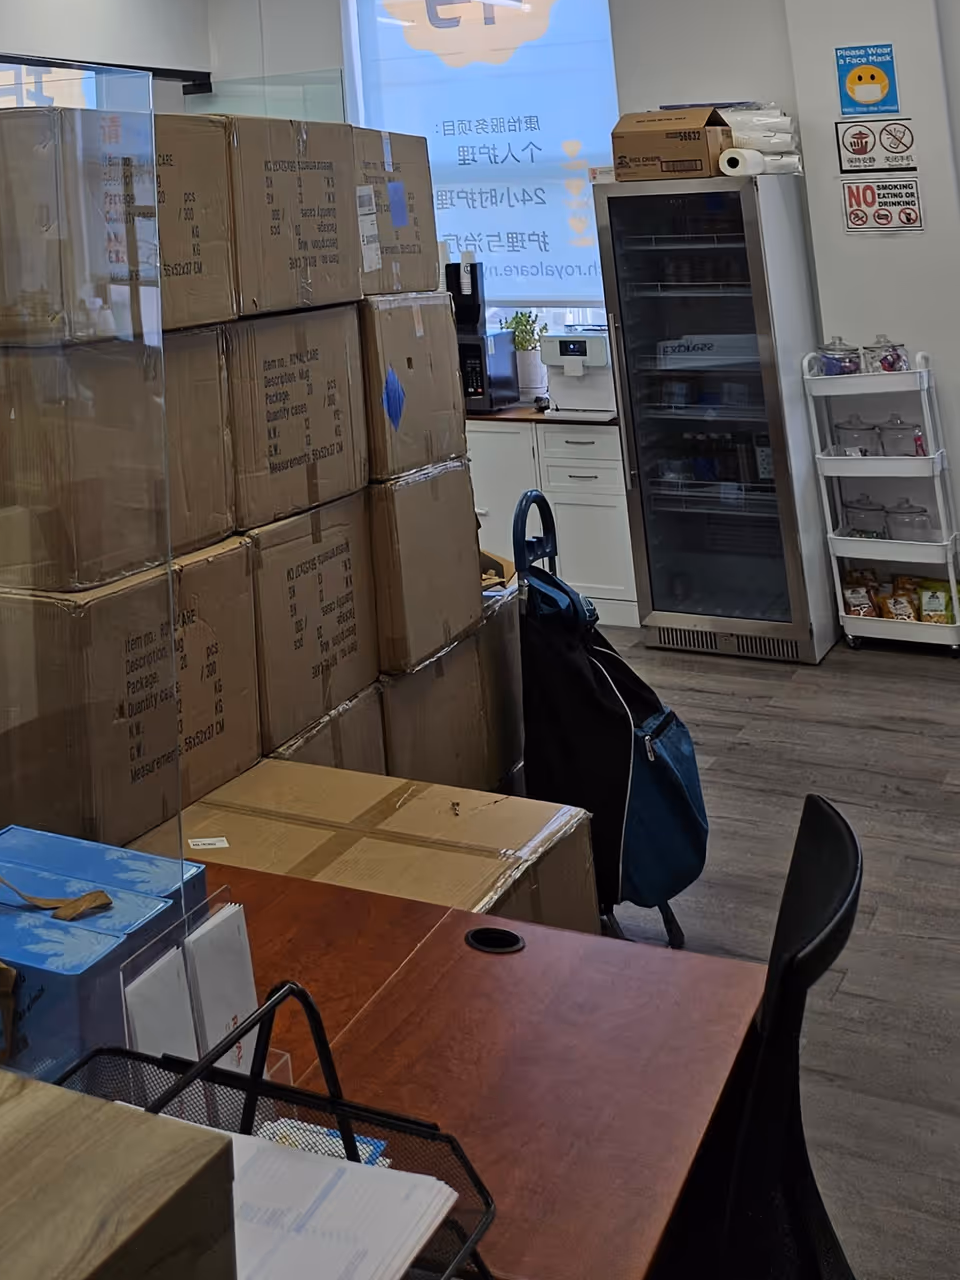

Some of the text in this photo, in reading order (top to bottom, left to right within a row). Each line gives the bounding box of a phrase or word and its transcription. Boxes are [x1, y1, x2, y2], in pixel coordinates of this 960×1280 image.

[678, 130, 701, 142] 56632
[158, 153, 176, 167] CARE
[183, 191, 196, 203] pcs
[848, 184, 876, 208] NO
[183, 208, 194, 221] 300
[191, 224, 200, 239] KG
[192, 242, 201, 257] KG
[193, 260, 202, 275] CM
[306, 348, 319, 361] CARE
[326, 379, 337, 392] pcs
[266, 406, 289, 423] Quantity
[125, 633, 142, 654] Item
[126, 643, 219, 696] Package: 20 pcs
[127, 693, 159, 719] Quantity
[205, 661, 217, 679] 300
[214, 679, 223, 694] KG
[215, 700, 224, 716] KG
[184, 728, 214, 752] 56x52x37
[216, 720, 225, 737] CM
